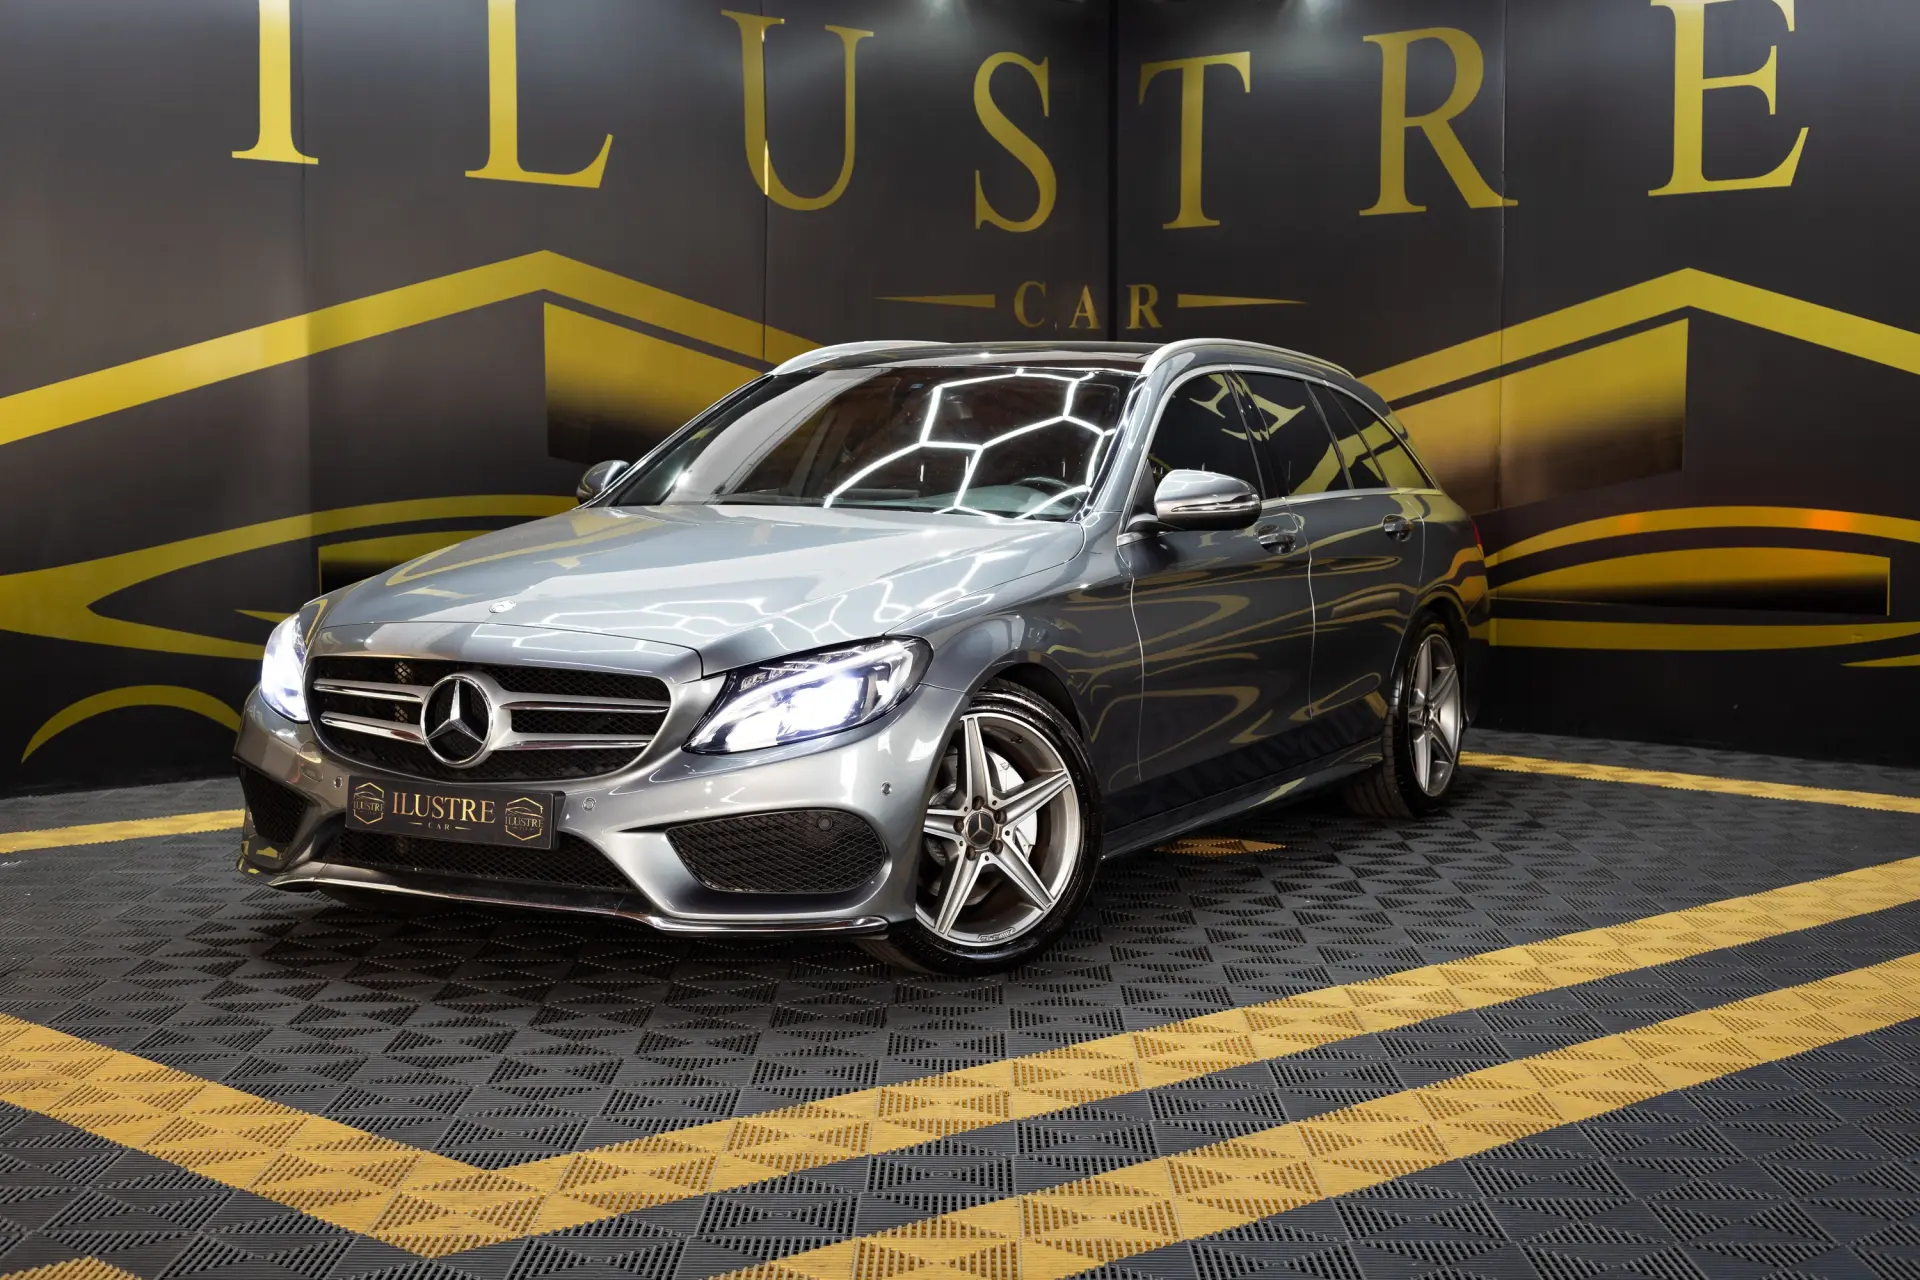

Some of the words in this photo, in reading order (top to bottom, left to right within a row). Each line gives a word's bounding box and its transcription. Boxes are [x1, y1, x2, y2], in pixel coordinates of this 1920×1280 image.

[231, 0, 1810, 233] ILUSTRE
[1013, 280, 1164, 330] CAR
[392, 792, 496, 824] ILUSTRE
[504, 815, 544, 829] ILUSTRE
[427, 821, 451, 831] CAR
